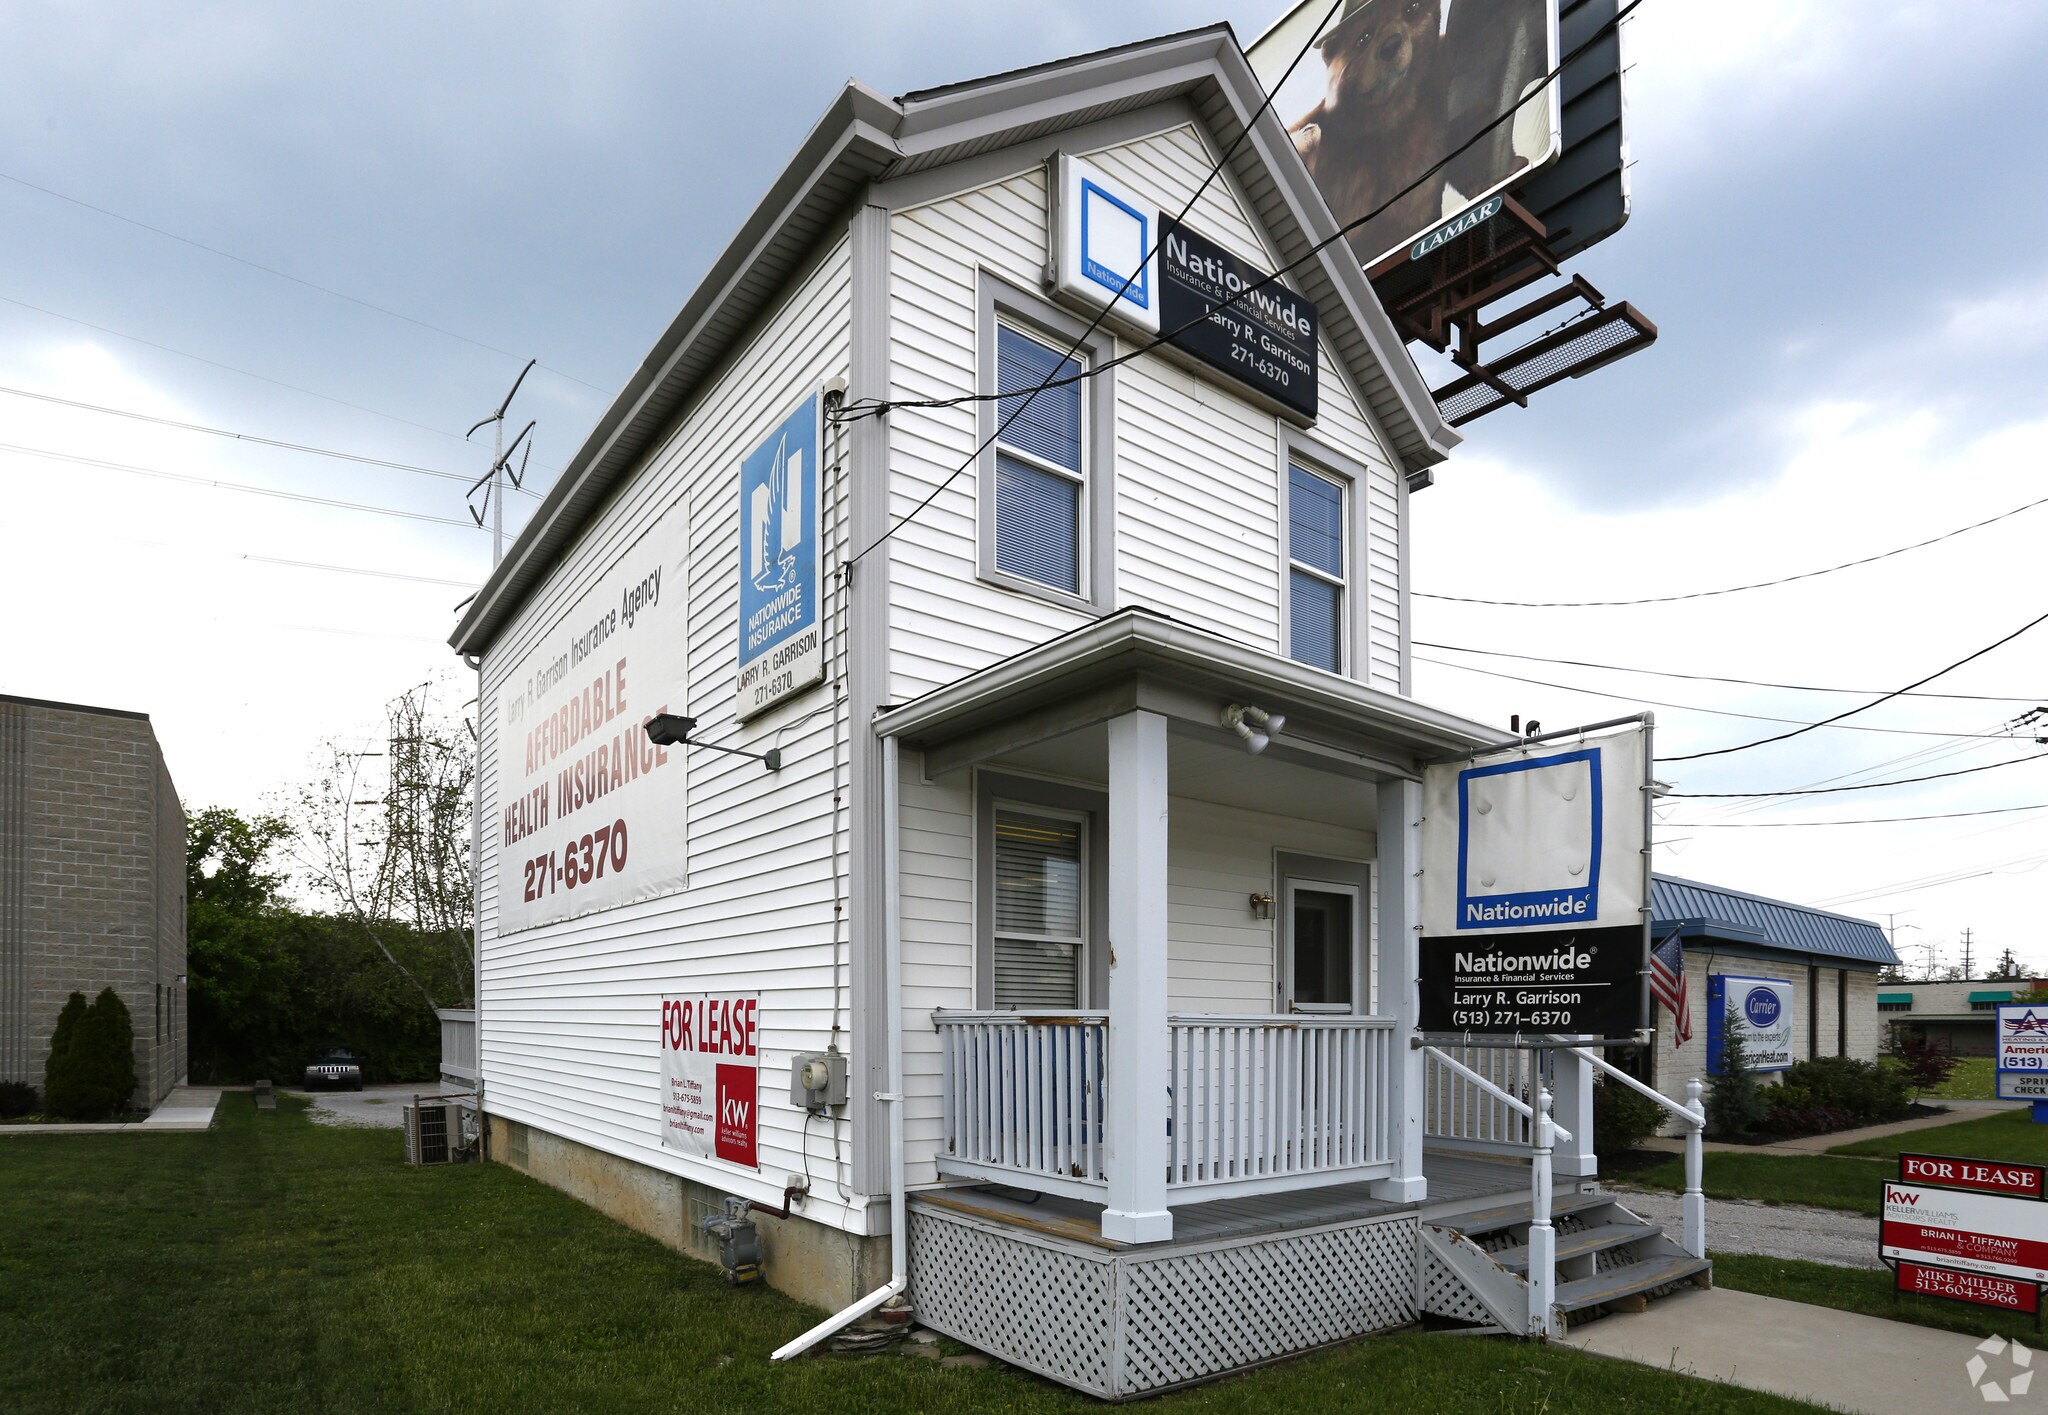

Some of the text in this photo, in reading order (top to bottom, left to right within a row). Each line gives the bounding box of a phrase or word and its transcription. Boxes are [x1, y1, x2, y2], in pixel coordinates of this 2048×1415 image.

[1420, 202, 1492, 254] LAMAR
[1087, 261, 1144, 302] Nationwide
[1166, 232, 1311, 336] Nationwide
[1166, 260, 1296, 340] Insurance & Financial Services
[1205, 304, 1311, 376] Larry R. Garrison
[1230, 342, 1290, 386] 271-6370
[748, 583, 802, 632] NATIONWIDE
[748, 603, 802, 650] INSURANCE
[508, 693, 525, 725] Larry
[536, 652, 568, 699] Garrison
[571, 608, 616, 669] Insurance
[621, 565, 662, 629] Agency
[737, 630, 817, 692] LARRY R. GARRISON
[754, 670, 792, 706] 271-6370
[525, 656, 626, 777] AFFORDABLE
[504, 704, 668, 848] HEALTH INSURANCE
[524, 818, 628, 904] 271-6370
[1466, 895, 1586, 922] Nationwide
[1454, 946, 1591, 972] Nationwide
[1454, 972, 1574, 982] Insurance & Financial Services
[1454, 990, 1581, 1008] Larry R. Garrison
[1750, 998, 1776, 1014] Carrier
[662, 999, 756, 1056] FOR LEASE
[1452, 1010, 1490, 1027] (513)
[1765, 1032, 1781, 1044] experts
[2004, 1056, 2042, 1069] (513)
[672, 1078, 682, 1088] Brian
[687, 1080, 702, 1092] Tiffany
[722, 1084, 749, 1128] kw
[722, 1127, 747, 1140] keller williams
[1907, 1160, 2036, 1188] FOR LEASE
[1887, 1186, 1920, 1206] kw
[1886, 1212, 1956, 1226] ADVISORS REALTY
[1921, 1228, 2018, 1250] BRIAN L. TIFFANY
[1966, 1243, 2018, 1257] COMPANY
[1936, 1256, 1996, 1270] brianltiffany.com
[1914, 1278, 2018, 1304] 513-604-5966
[1917, 1269, 2016, 1294] MIKE MILLER
